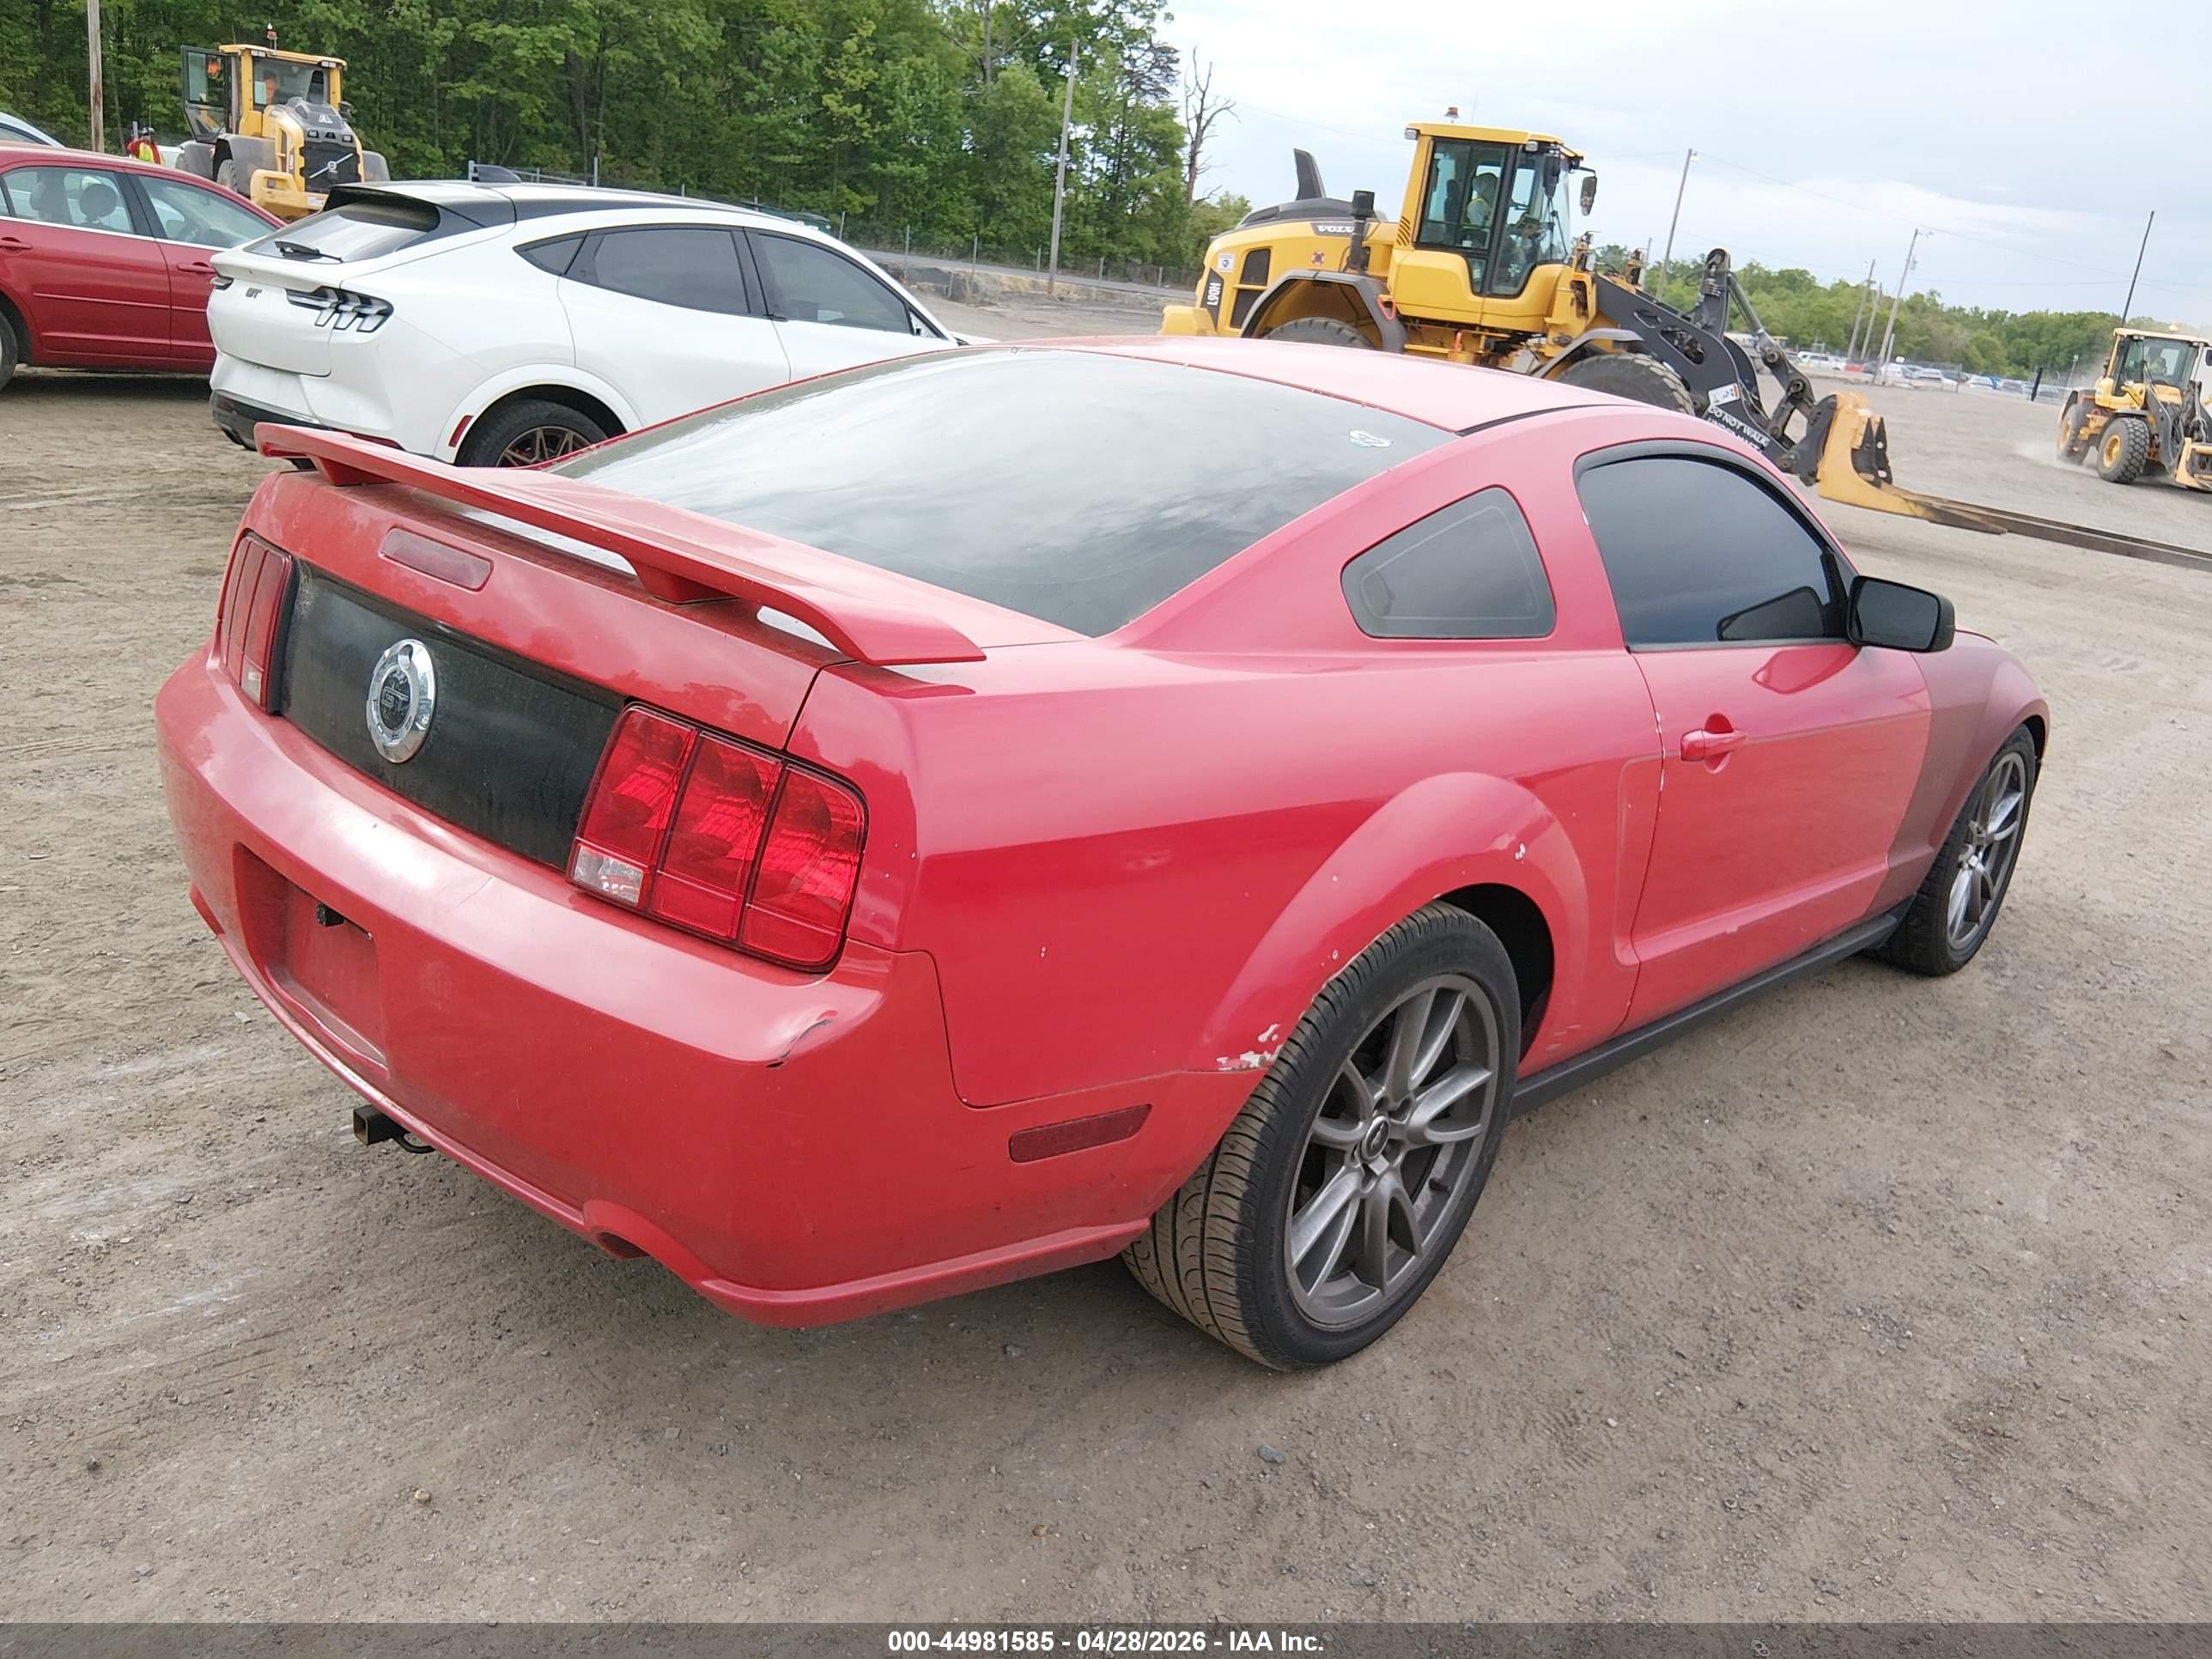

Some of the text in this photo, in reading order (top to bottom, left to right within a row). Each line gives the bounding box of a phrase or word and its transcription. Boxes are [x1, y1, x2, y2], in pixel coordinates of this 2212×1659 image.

[1316, 225, 1354, 234] VOLV
[1206, 282, 1221, 306] L90H
[1722, 410, 1744, 430] NOT
[1742, 427, 1771, 447] WALK
[380, 685, 410, 711] GT
